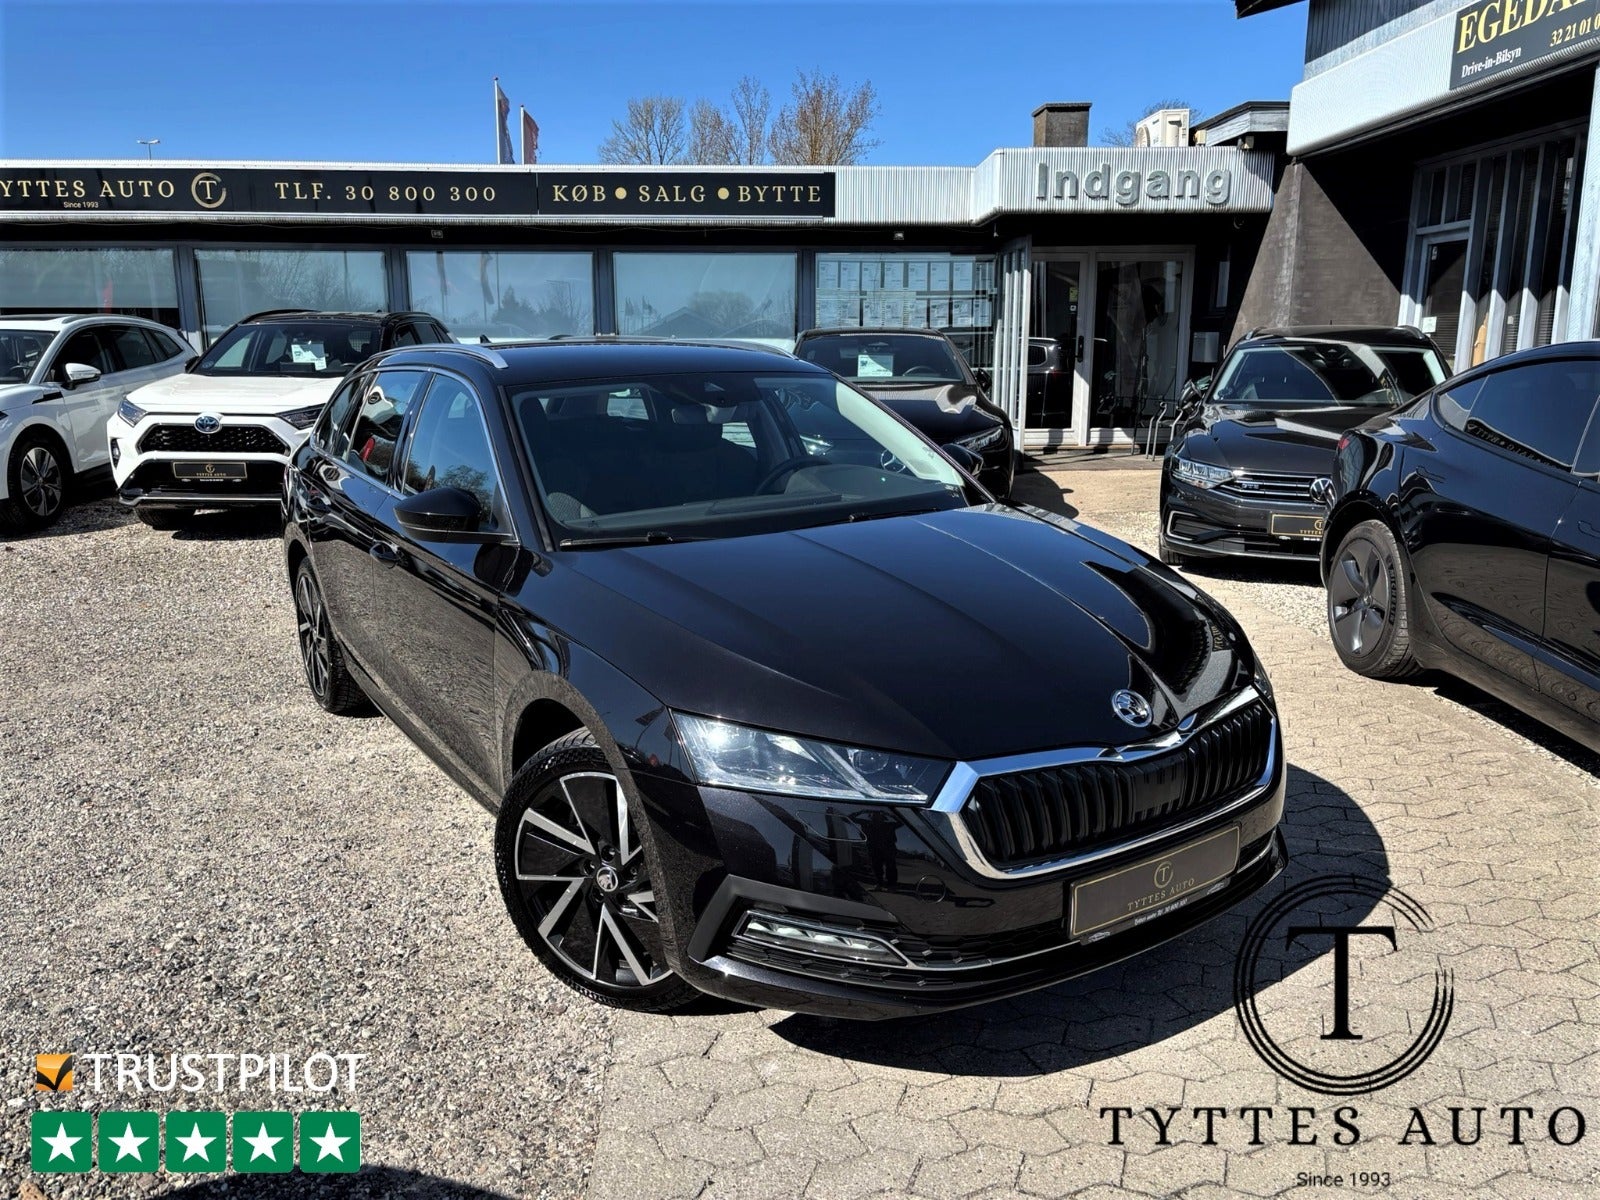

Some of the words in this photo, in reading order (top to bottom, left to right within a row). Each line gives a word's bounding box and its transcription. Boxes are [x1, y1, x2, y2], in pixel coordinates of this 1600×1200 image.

[1550, 28, 1563, 47] 32
[1564, 23, 1577, 42] 21
[1579, 17, 1592, 36] 01
[1461, 47, 1522, 78] Drive-in-Bilsyn
[99, 180, 175, 198] AUTO
[274, 182, 332, 200] TLF.
[346, 186, 374, 201] 30
[388, 187, 435, 202] 800
[450, 187, 496, 202] 300
[553, 184, 607, 203] KØB
[638, 185, 706, 203] SALG
[738, 185, 822, 203] BYTTE
[1036, 162, 1232, 206] Indgang
[63, 201, 82, 209] Since
[83, 201, 99, 209] 1993
[1127, 889, 1166, 912] TYTTES
[1169, 878, 1195, 896] AUTO
